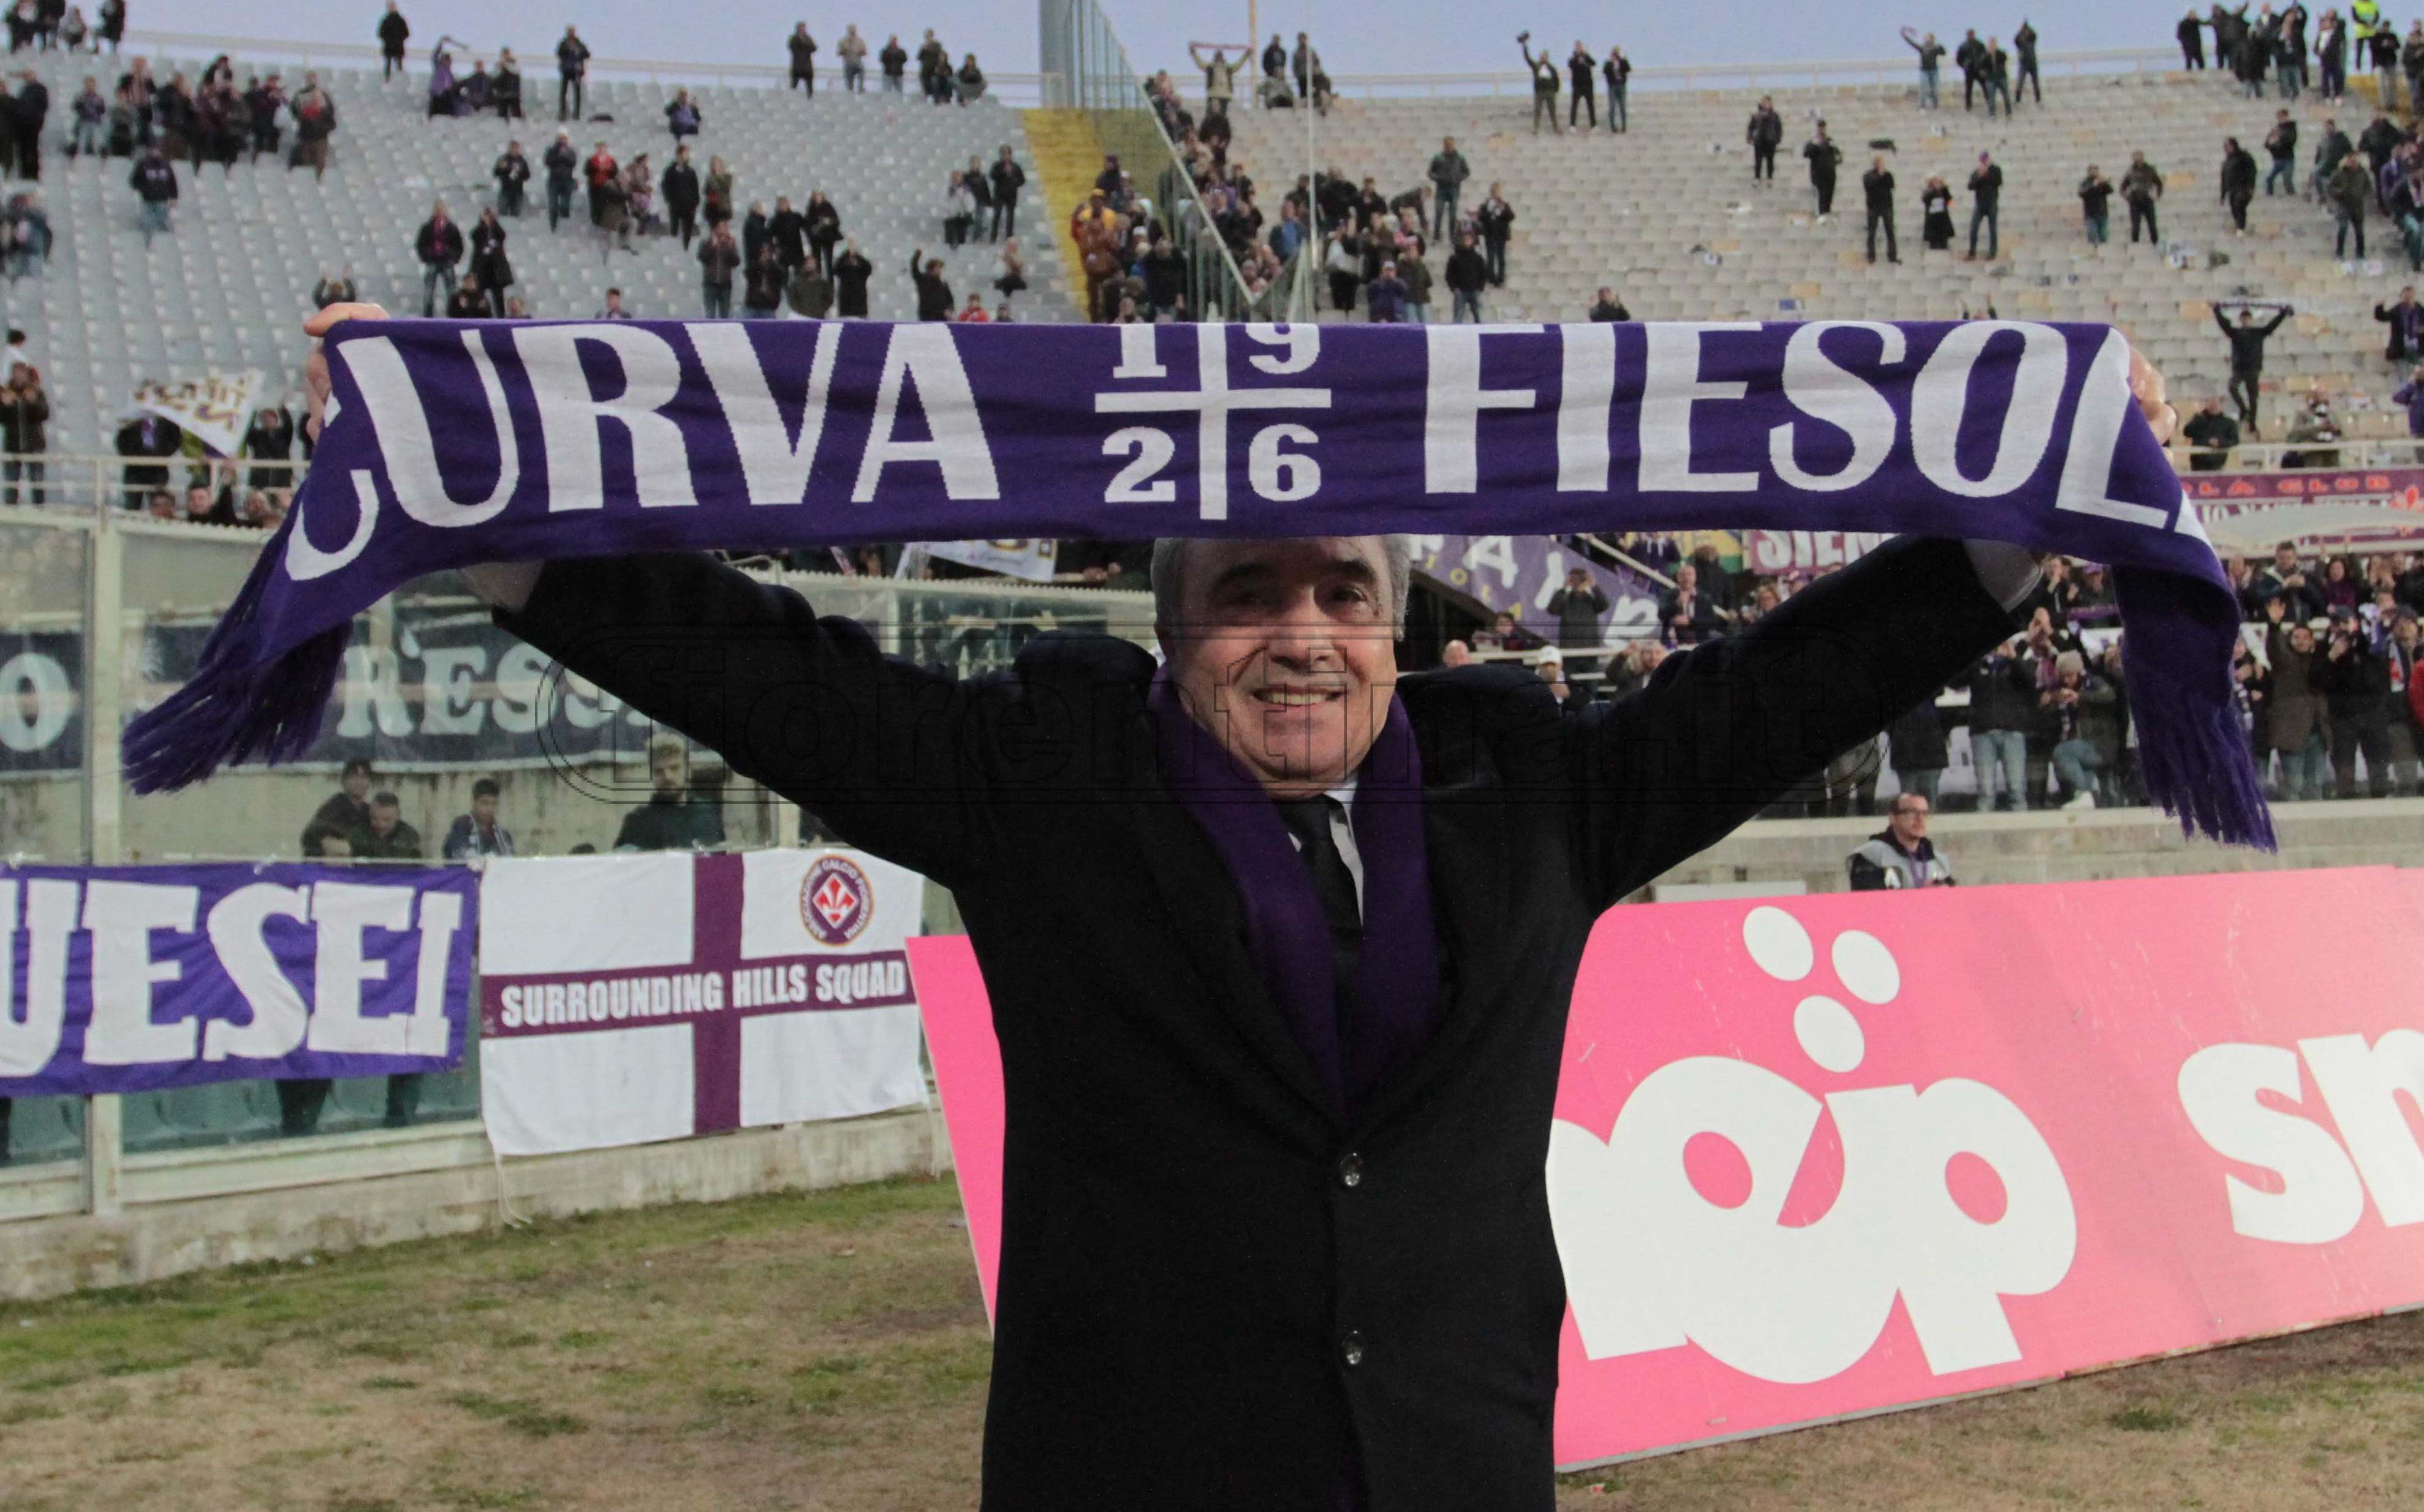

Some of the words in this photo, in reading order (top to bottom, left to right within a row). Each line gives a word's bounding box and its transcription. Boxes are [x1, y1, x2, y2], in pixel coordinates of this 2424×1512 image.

[1424, 321, 2214, 548] FIESOL
[822, 860, 858, 879] CALCIO
[501, 972, 724, 1028] SURROUNDING
[732, 963, 808, 1008] HILLS
[816, 959, 907, 1005] SQUAD
